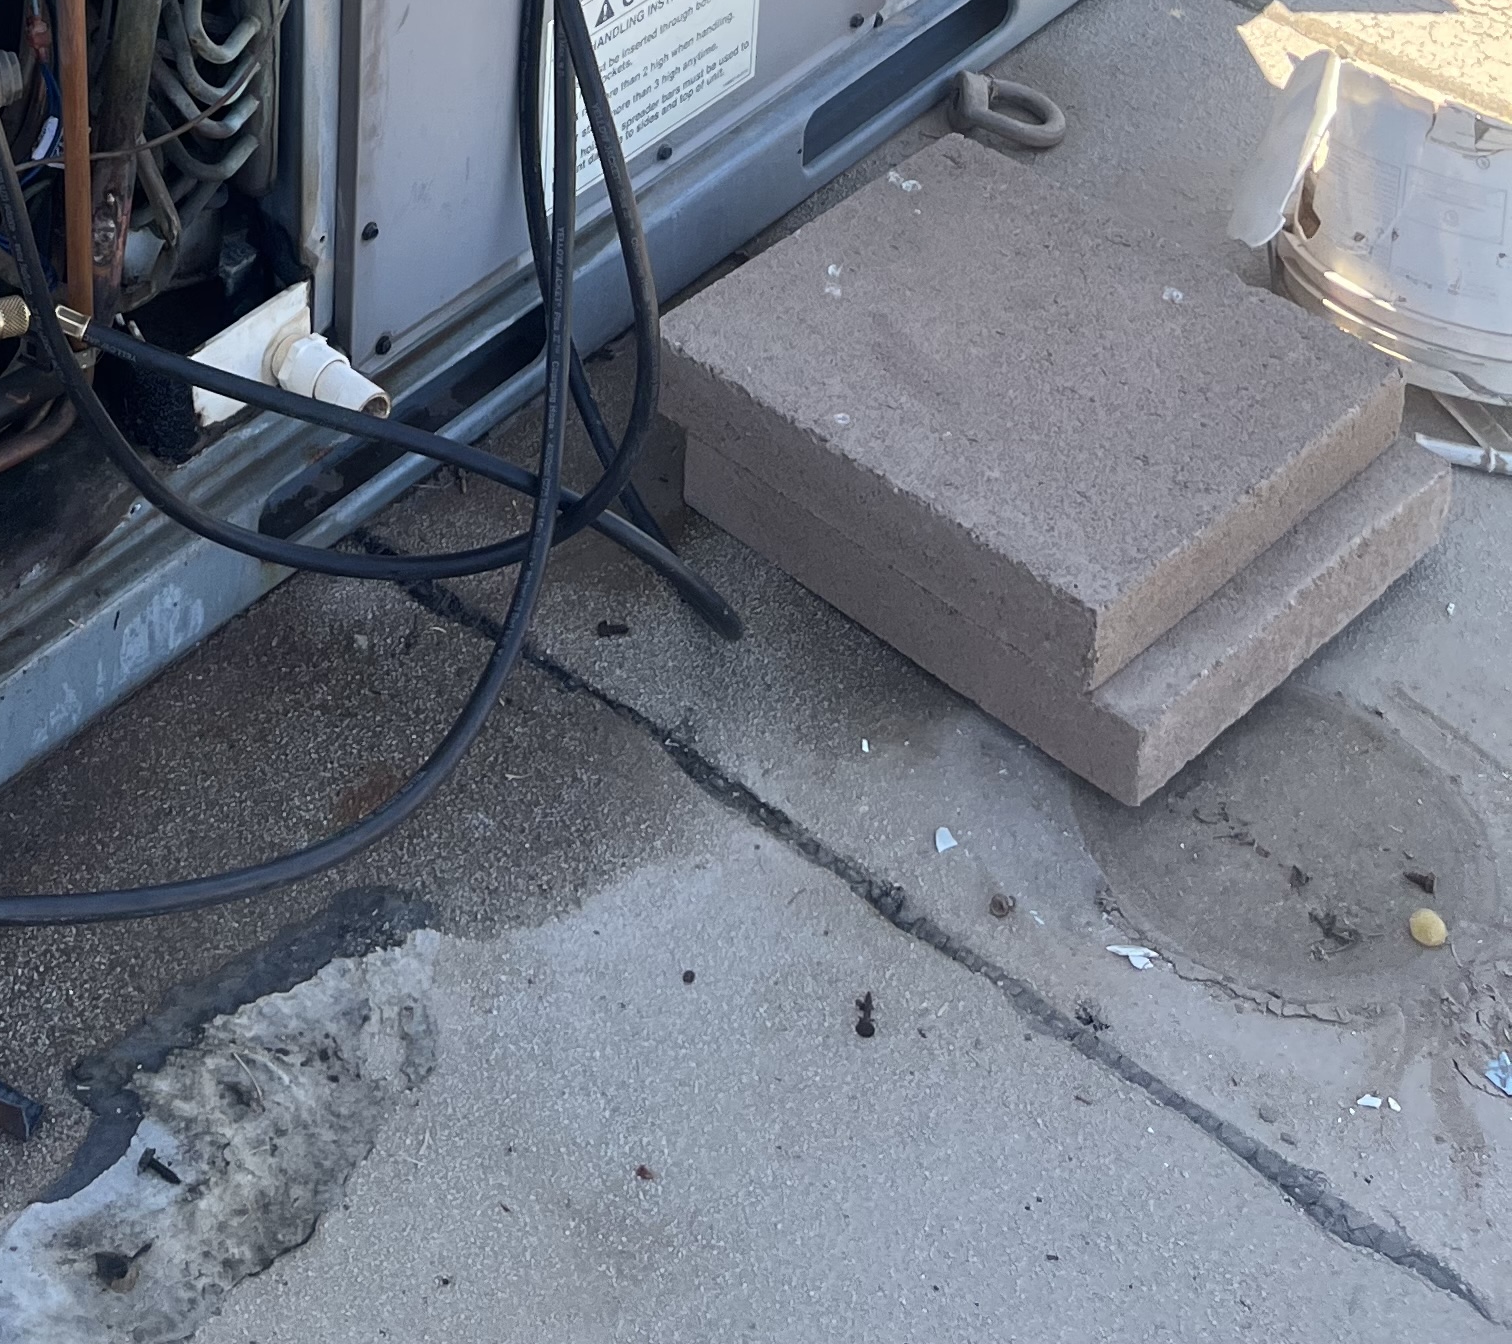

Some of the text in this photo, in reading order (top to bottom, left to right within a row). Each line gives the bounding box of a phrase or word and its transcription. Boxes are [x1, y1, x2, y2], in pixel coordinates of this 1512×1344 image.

[608, 54, 620, 68] be
[621, 28, 658, 58] inserted
[659, 6, 694, 36] through
[620, 69, 641, 92] than
[642, 66, 649, 77] 2
[650, 53, 669, 72] high
[671, 37, 694, 58] when
[695, 11, 735, 42] handling.
[601, 58, 633, 83] ockets.
[621, 100, 660, 130] spreader
[661, 85, 681, 103] bars
[682, 70, 705, 90] must
[706, 61, 717, 74] be
[718, 46, 739, 66] used
[740, 40, 750, 52] to
[632, 85, 652, 103] than
[654, 78, 660, 90] 3
[661, 65, 681, 88] high
[682, 43, 719, 71] anytime.
[625, 128, 635, 140] to
[636, 112, 660, 132] sides
[661, 99, 678, 115] and
[679, 88, 694, 105] top
[696, 80, 705, 93] of
[706, 68, 725, 86] unit.
[556, 226, 565, 265] YELLOW
[99, 341, 139, 363] YELLOW
[549, 360, 559, 403] Charging
[548, 405, 557, 429] Hose
